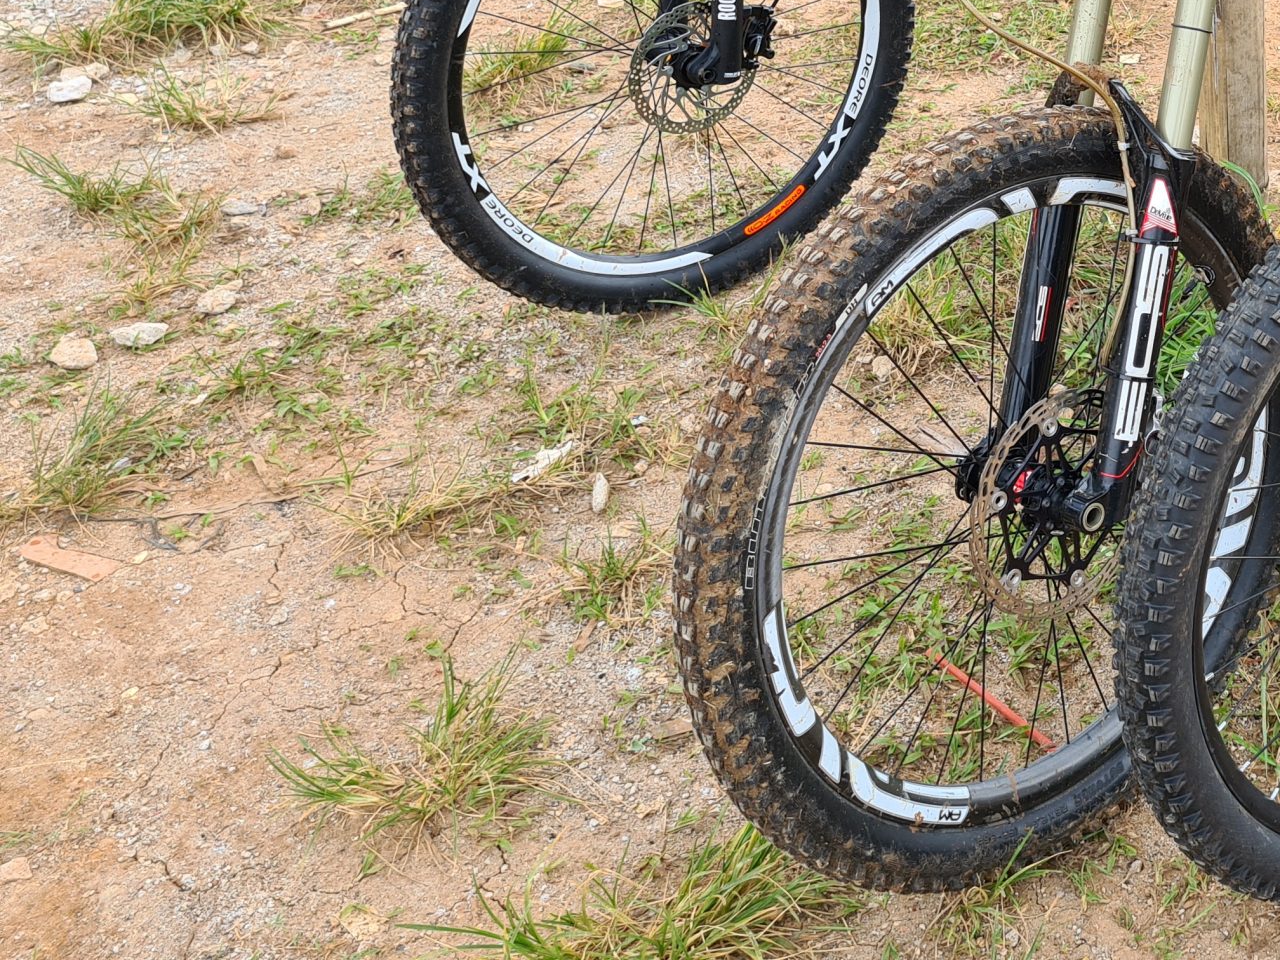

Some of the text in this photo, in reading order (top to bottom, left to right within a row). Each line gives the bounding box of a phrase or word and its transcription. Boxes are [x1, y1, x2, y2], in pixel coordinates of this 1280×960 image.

[813, 53, 874, 182] DEORE XT
[450, 131, 535, 244] XT DEORE
[870, 280, 895, 308] AM
